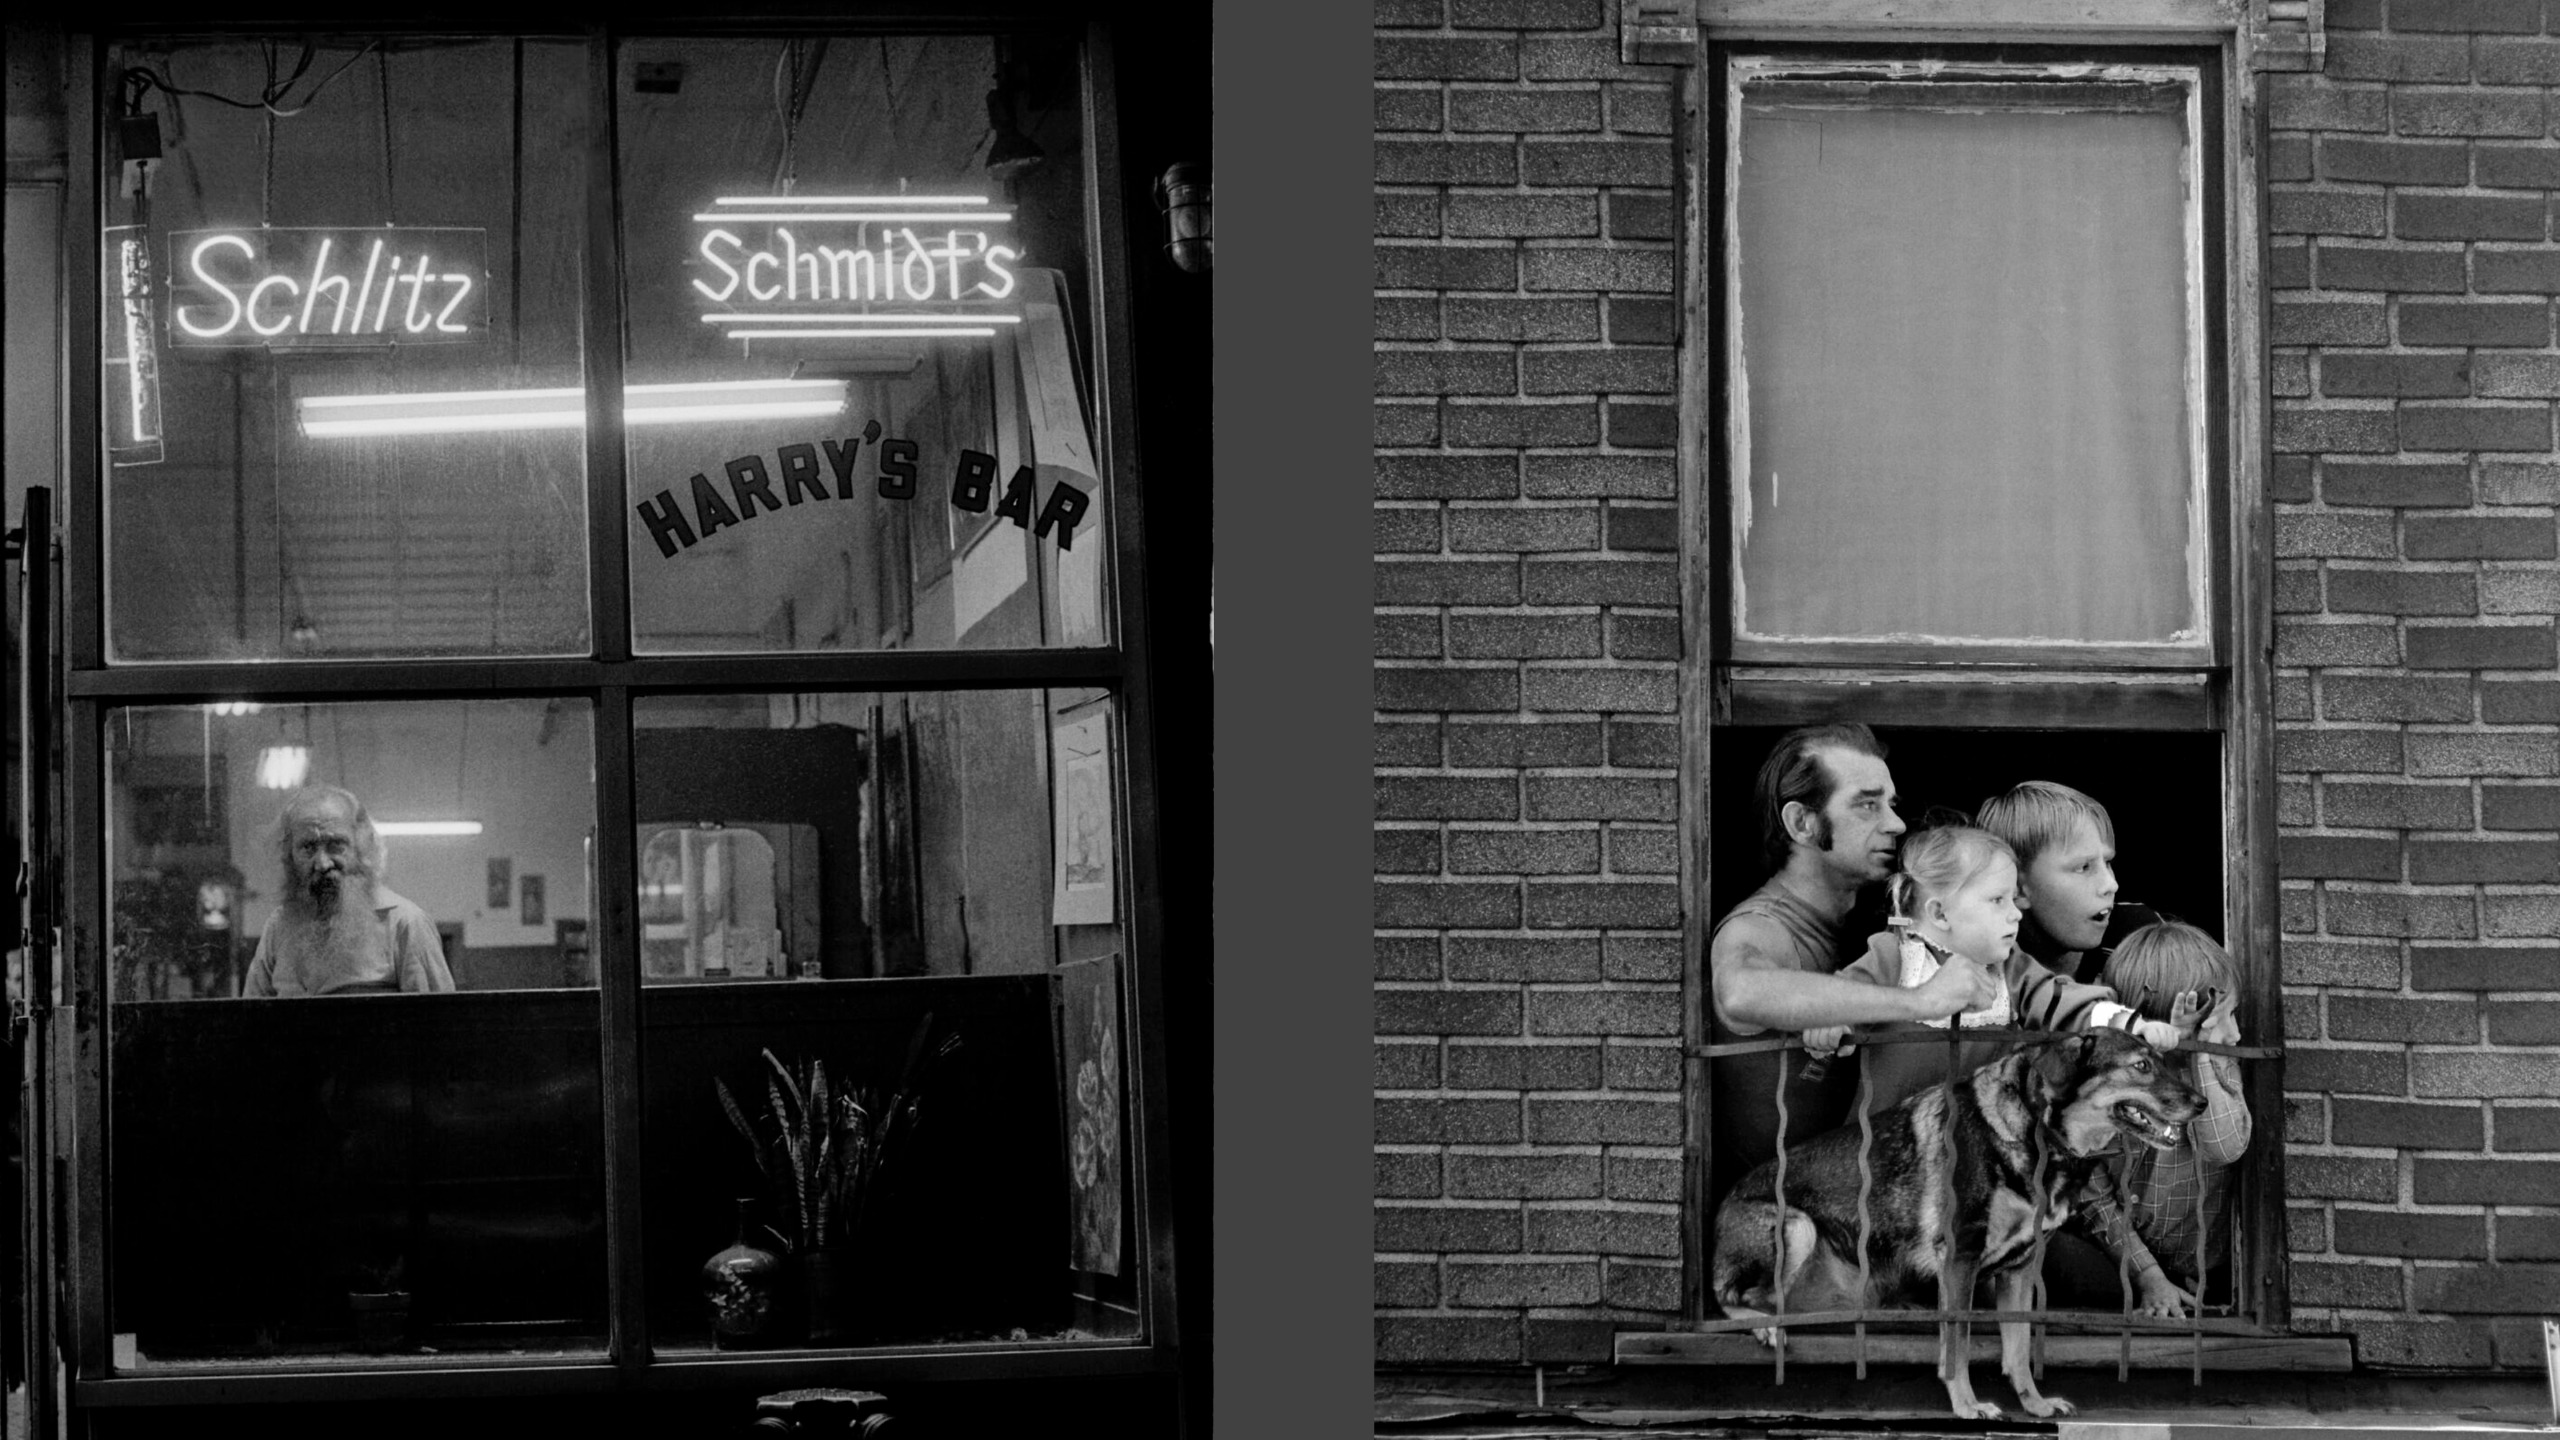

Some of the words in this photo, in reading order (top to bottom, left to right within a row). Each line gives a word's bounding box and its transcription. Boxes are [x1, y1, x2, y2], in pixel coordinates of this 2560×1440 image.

[177, 236, 472, 338] Schlitz
[692, 228, 1018, 302] Schmidt's
[636, 419, 919, 559] HARRY'S
[950, 448, 1091, 552] BAR
